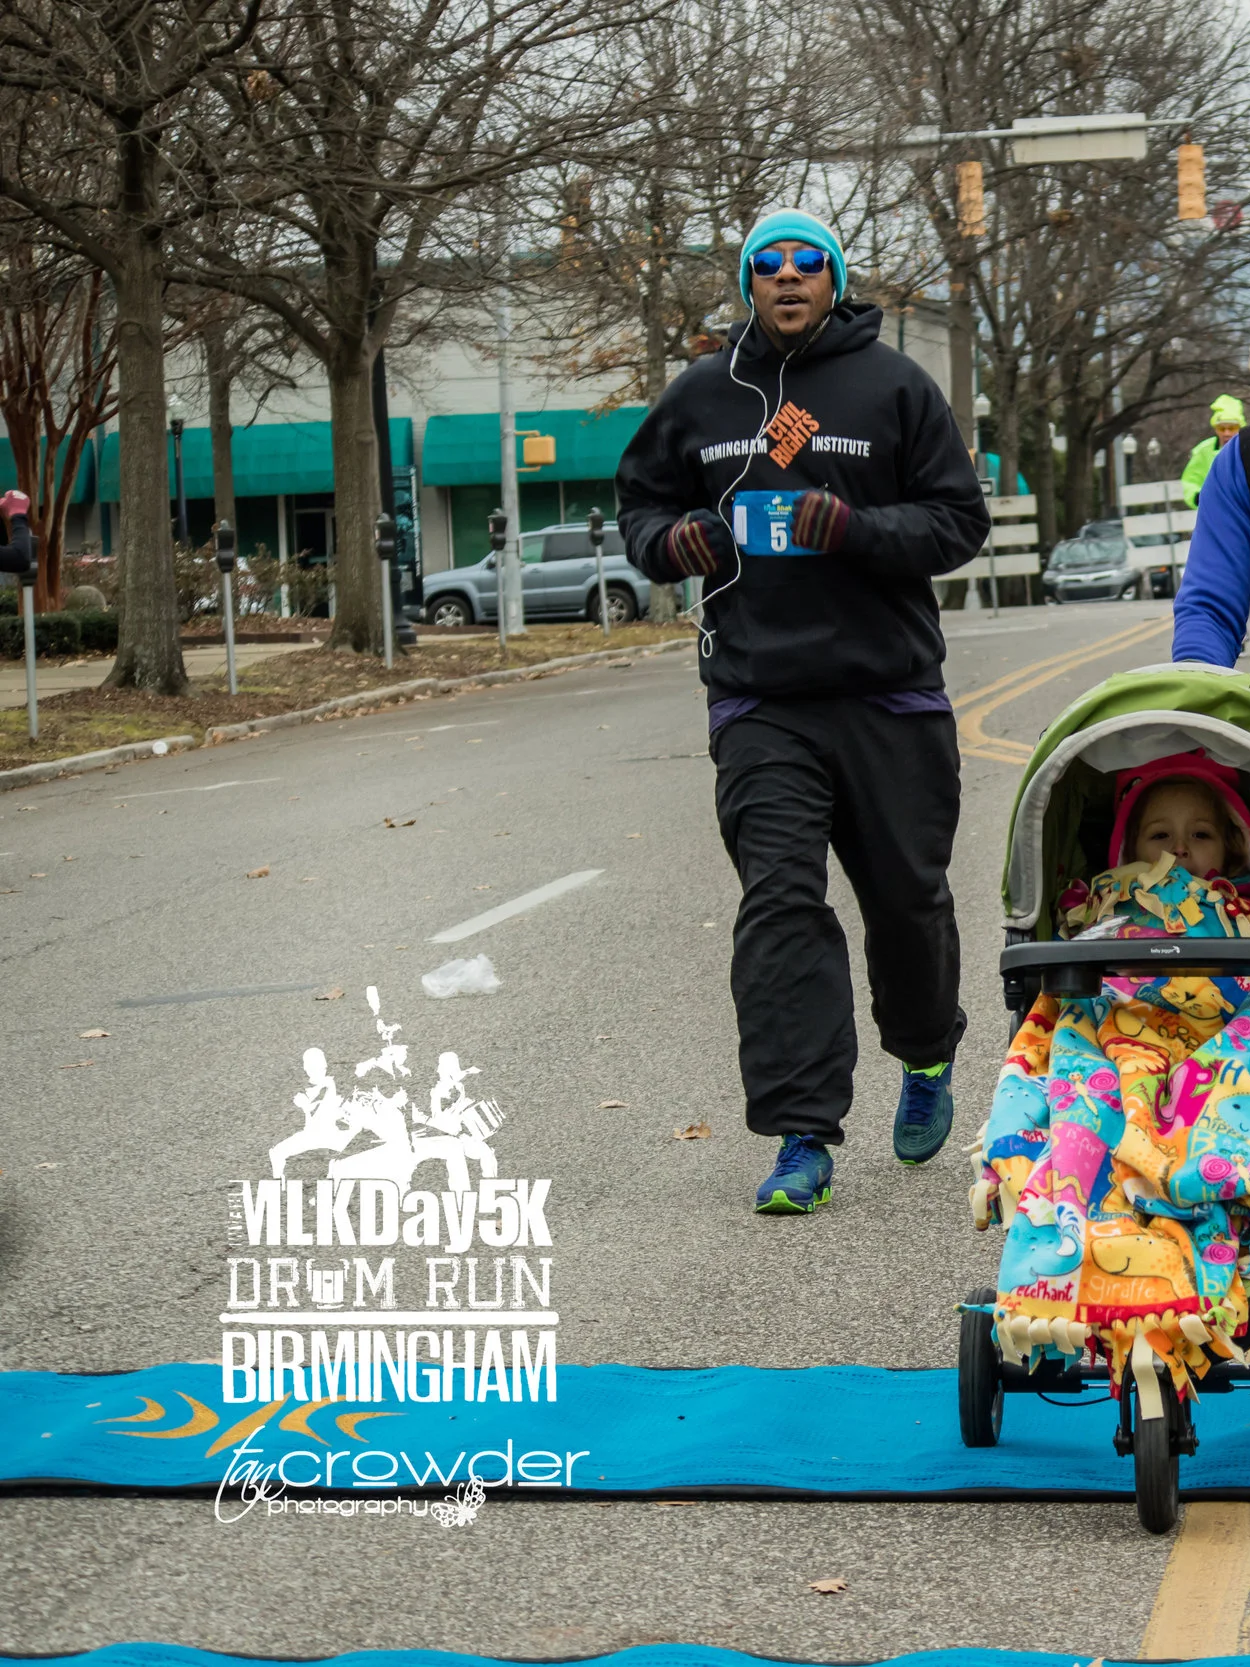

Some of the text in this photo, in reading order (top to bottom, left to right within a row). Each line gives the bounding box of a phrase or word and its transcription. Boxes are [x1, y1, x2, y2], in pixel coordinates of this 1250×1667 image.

[766, 400, 807, 442] CIVIL
[700, 435, 870, 465] BIRMINGHAM INSTITUTE
[769, 412, 820, 470] RIGHTS
[770, 521, 788, 552] 5
[1086, 1274, 1157, 1304] giraffe
